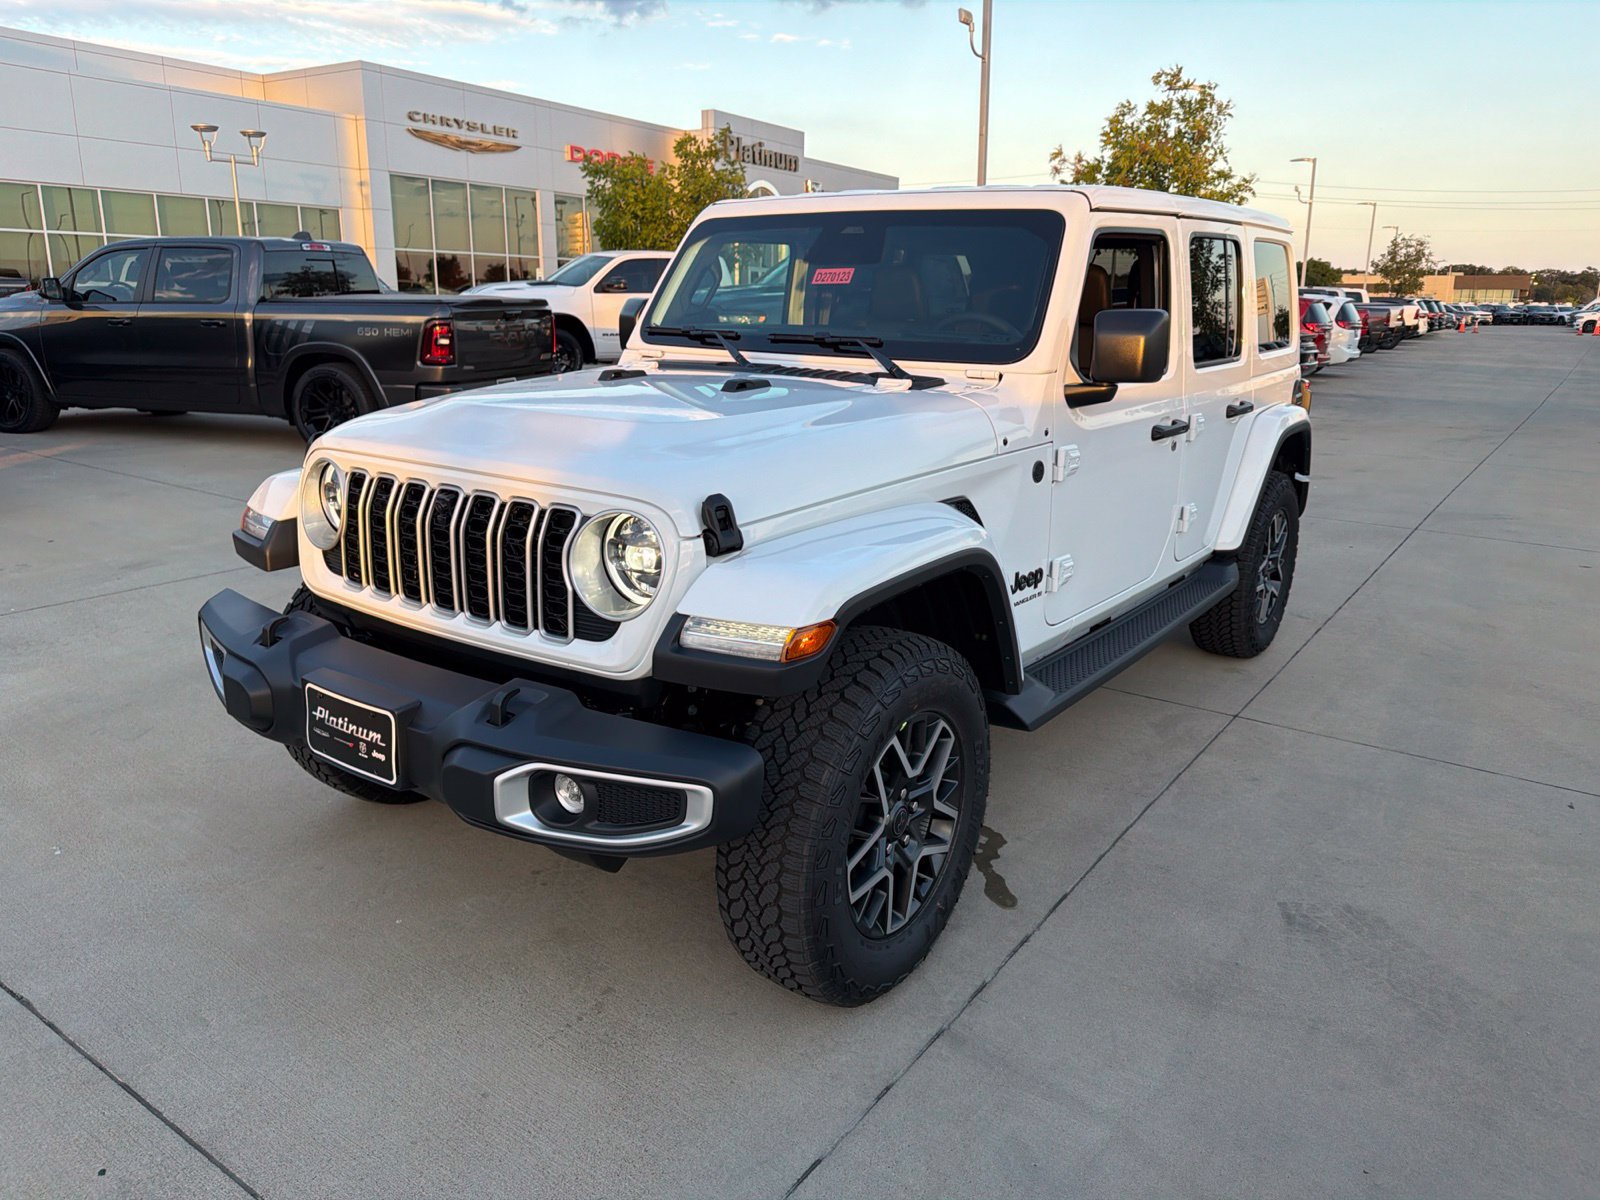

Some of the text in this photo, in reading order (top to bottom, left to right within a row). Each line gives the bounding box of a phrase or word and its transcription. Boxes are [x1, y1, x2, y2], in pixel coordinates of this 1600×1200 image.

[407, 110, 519, 139] CHRYSLER
[815, 271, 852, 282] D270123
[357, 327, 412, 337] 650 HEMI
[1010, 567, 1043, 595] Jeep
[312, 706, 386, 746] Platinum
